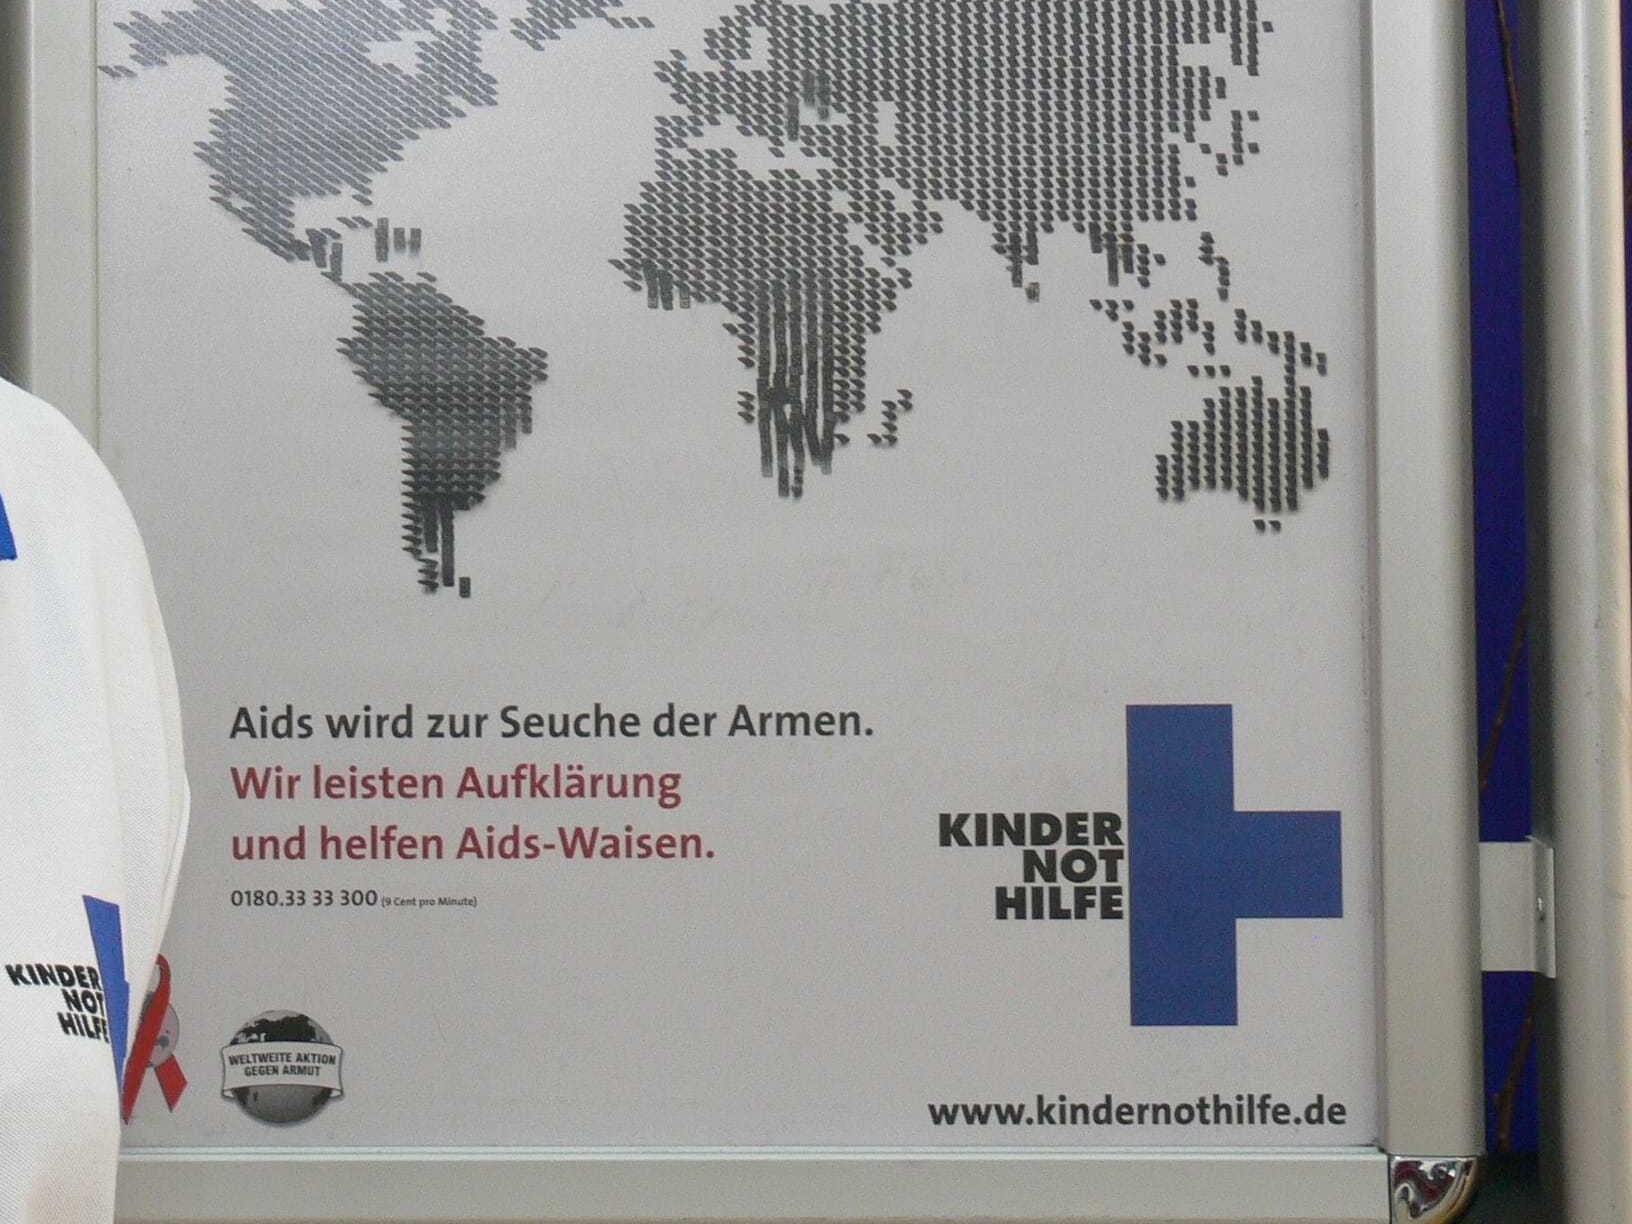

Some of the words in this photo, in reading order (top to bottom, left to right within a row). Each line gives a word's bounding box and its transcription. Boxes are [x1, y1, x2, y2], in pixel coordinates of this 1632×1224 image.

[229, 704, 314, 739] Aids
[324, 703, 414, 739] wird
[426, 712, 490, 739] zur
[500, 702, 641, 739] Seuche
[652, 702, 718, 738] der
[727, 704, 875, 738] Armen.
[230, 764, 302, 800] Wir
[313, 764, 444, 800] leisten
[455, 763, 682, 809] Aufklärung
[231, 824, 306, 861] und
[320, 824, 444, 861] helfen
[455, 823, 716, 860] Aids-Waisen.
[939, 811, 1124, 848] KINDER
[1022, 848, 1125, 884] NOT
[230, 889, 306, 907] 0180.33
[312, 889, 334, 907] 33
[340, 889, 378, 907] 300
[394, 896, 417, 907] Cent
[419, 897, 436, 909] pro
[438, 895, 478, 908] Minute)
[995, 885, 1124, 922] HILFE
[5, 963, 103, 990] KINDER
[62, 989, 105, 1017] NOT
[228, 1052, 292, 1066] WELTWEITE
[295, 1052, 337, 1066] AKTION
[244, 1065, 279, 1077] GEGEN
[282, 1065, 321, 1077] ARMUT
[927, 1093, 1347, 1127] www.kindernothilfe.de
